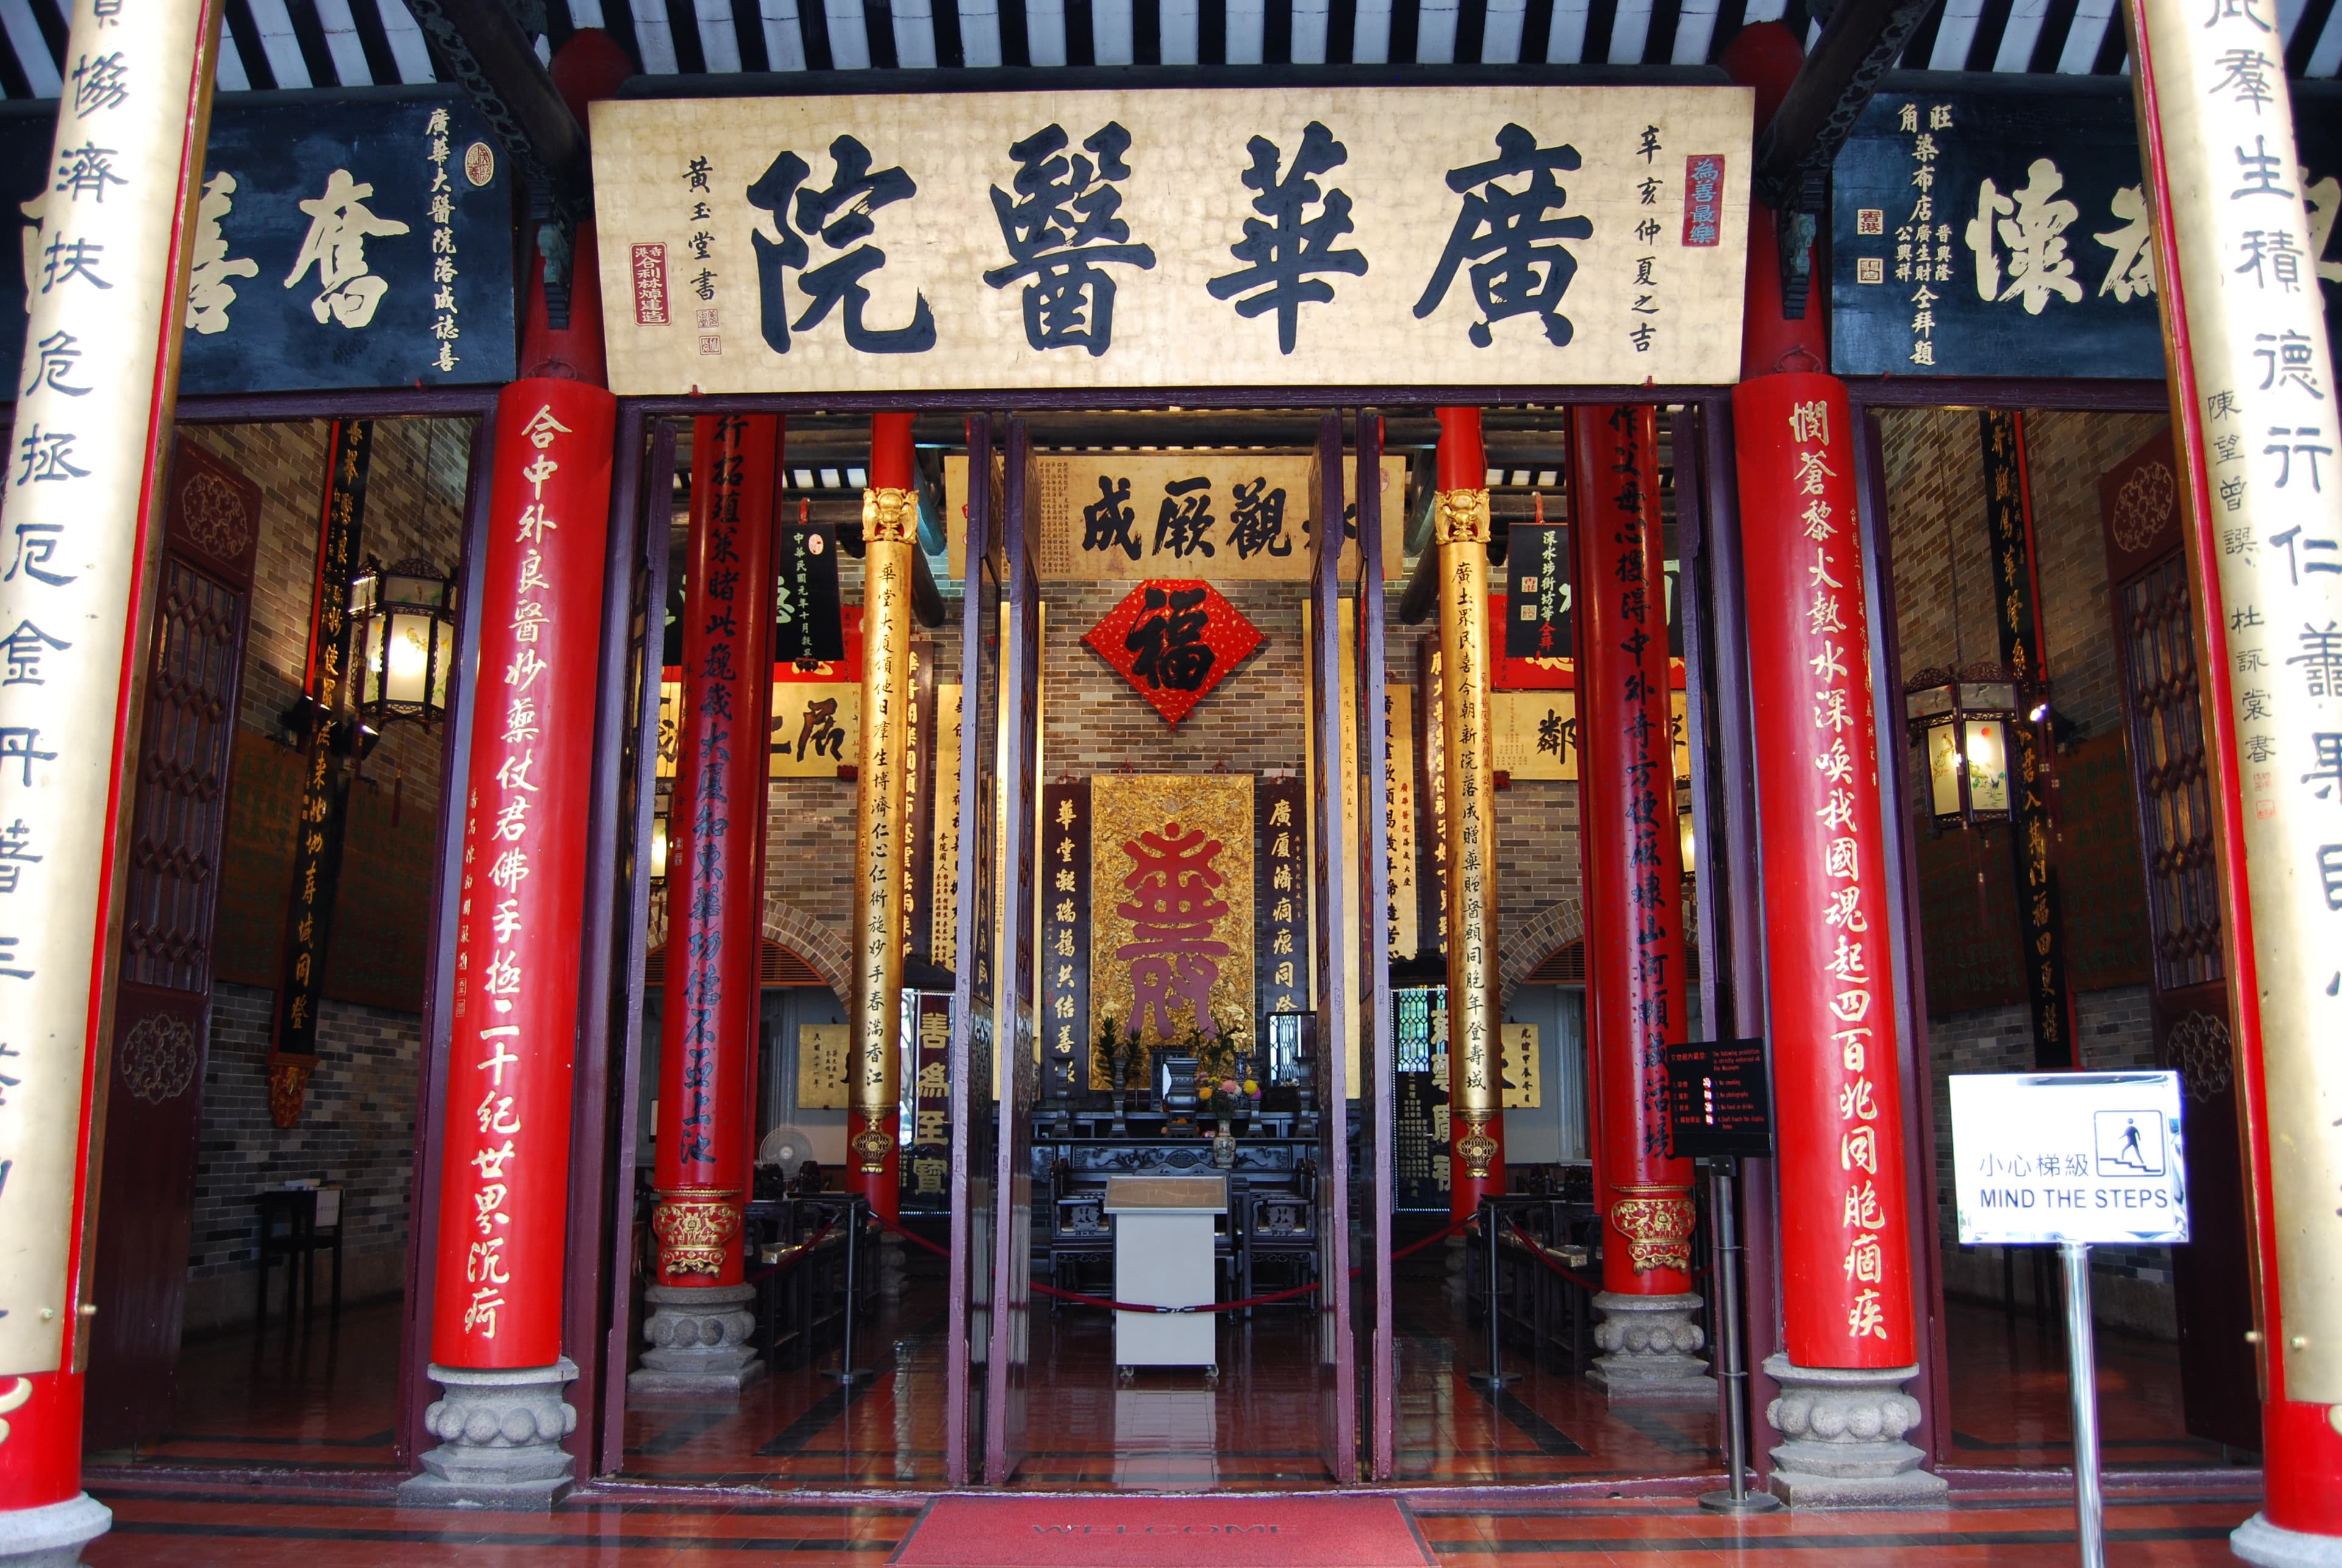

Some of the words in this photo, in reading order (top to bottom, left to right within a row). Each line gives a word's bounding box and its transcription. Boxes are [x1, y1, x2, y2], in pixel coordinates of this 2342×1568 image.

[426, 109, 460, 372] 廣華大醫院落成誌喜
[682, 156, 717, 301] 黃玉堂書
[747, 120, 1594, 356] 廣華醫院
[1630, 124, 1662, 353] 辛亥仲夏之吉
[1860, 211, 1881, 233] 香港
[1125, 587, 1216, 691] 福
[1980, 1153, 2089, 1178] 小心梯級
[1980, 1189, 2035, 1208] MIND
[2043, 1189, 2086, 1208] THE
[2095, 1189, 2168, 1208] STEPS
